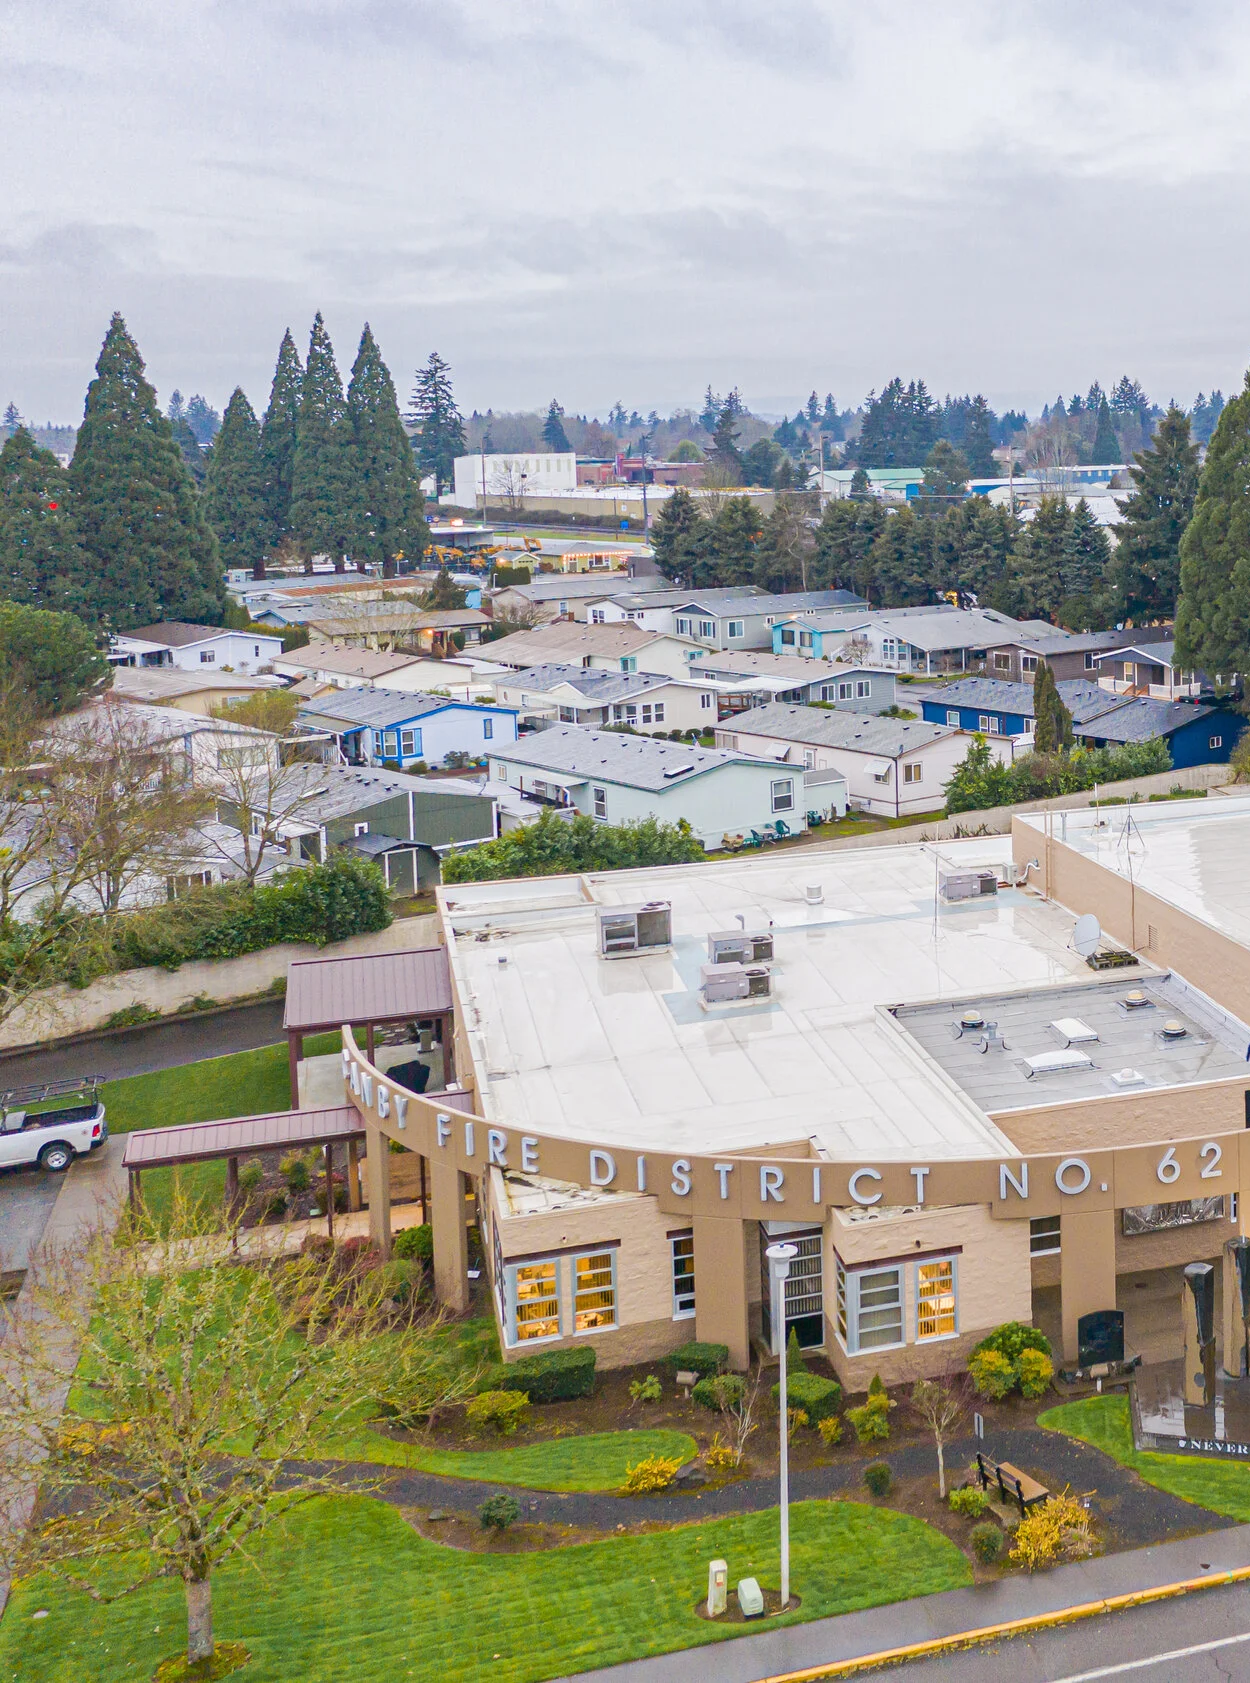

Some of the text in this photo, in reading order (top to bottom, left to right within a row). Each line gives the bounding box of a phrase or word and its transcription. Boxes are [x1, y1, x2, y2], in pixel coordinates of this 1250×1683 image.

[436, 1113, 540, 1173] FIRE
[589, 1150, 930, 1205] DISTRICT
[999, 1158, 1109, 1200] NO.
[1156, 1141, 1223, 1185] 62
[1190, 1440, 1249, 1455] NEVER
